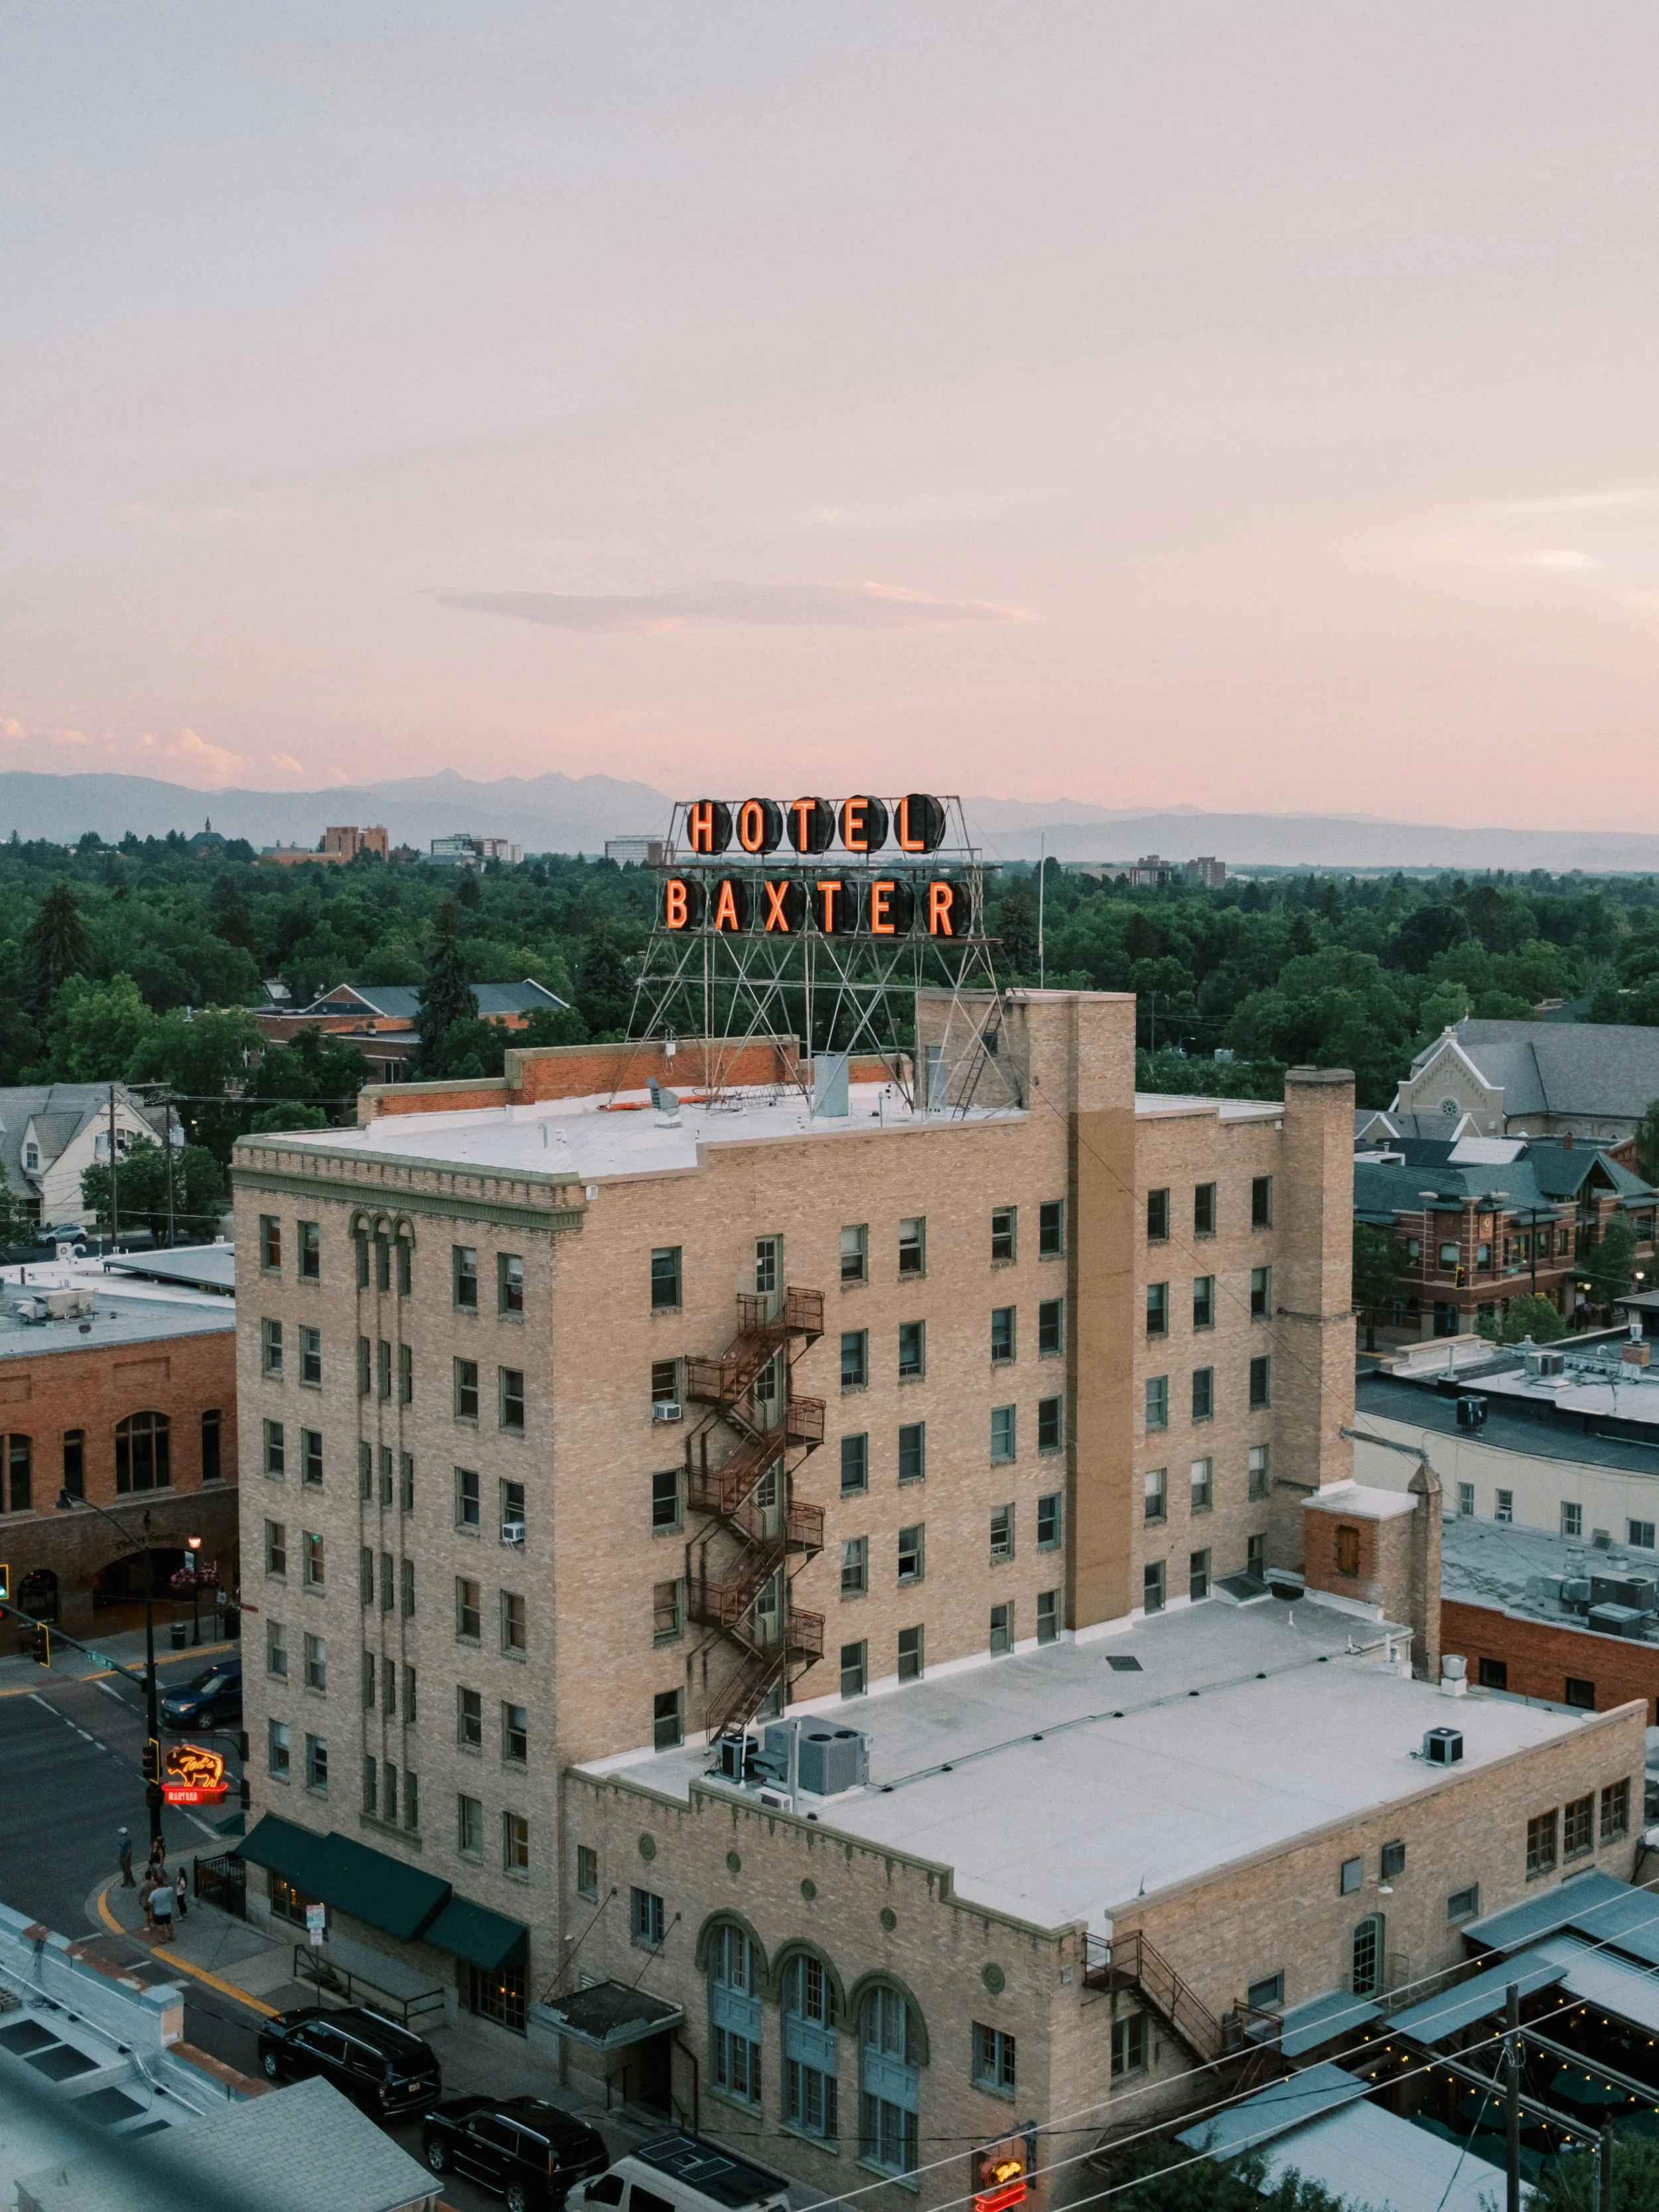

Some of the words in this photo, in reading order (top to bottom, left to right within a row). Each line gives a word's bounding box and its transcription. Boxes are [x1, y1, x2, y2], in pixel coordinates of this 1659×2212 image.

[692, 798, 924, 851] HOTEL
[667, 879, 953, 935] BAXTER
[179, 1756, 215, 1773] Ted's
